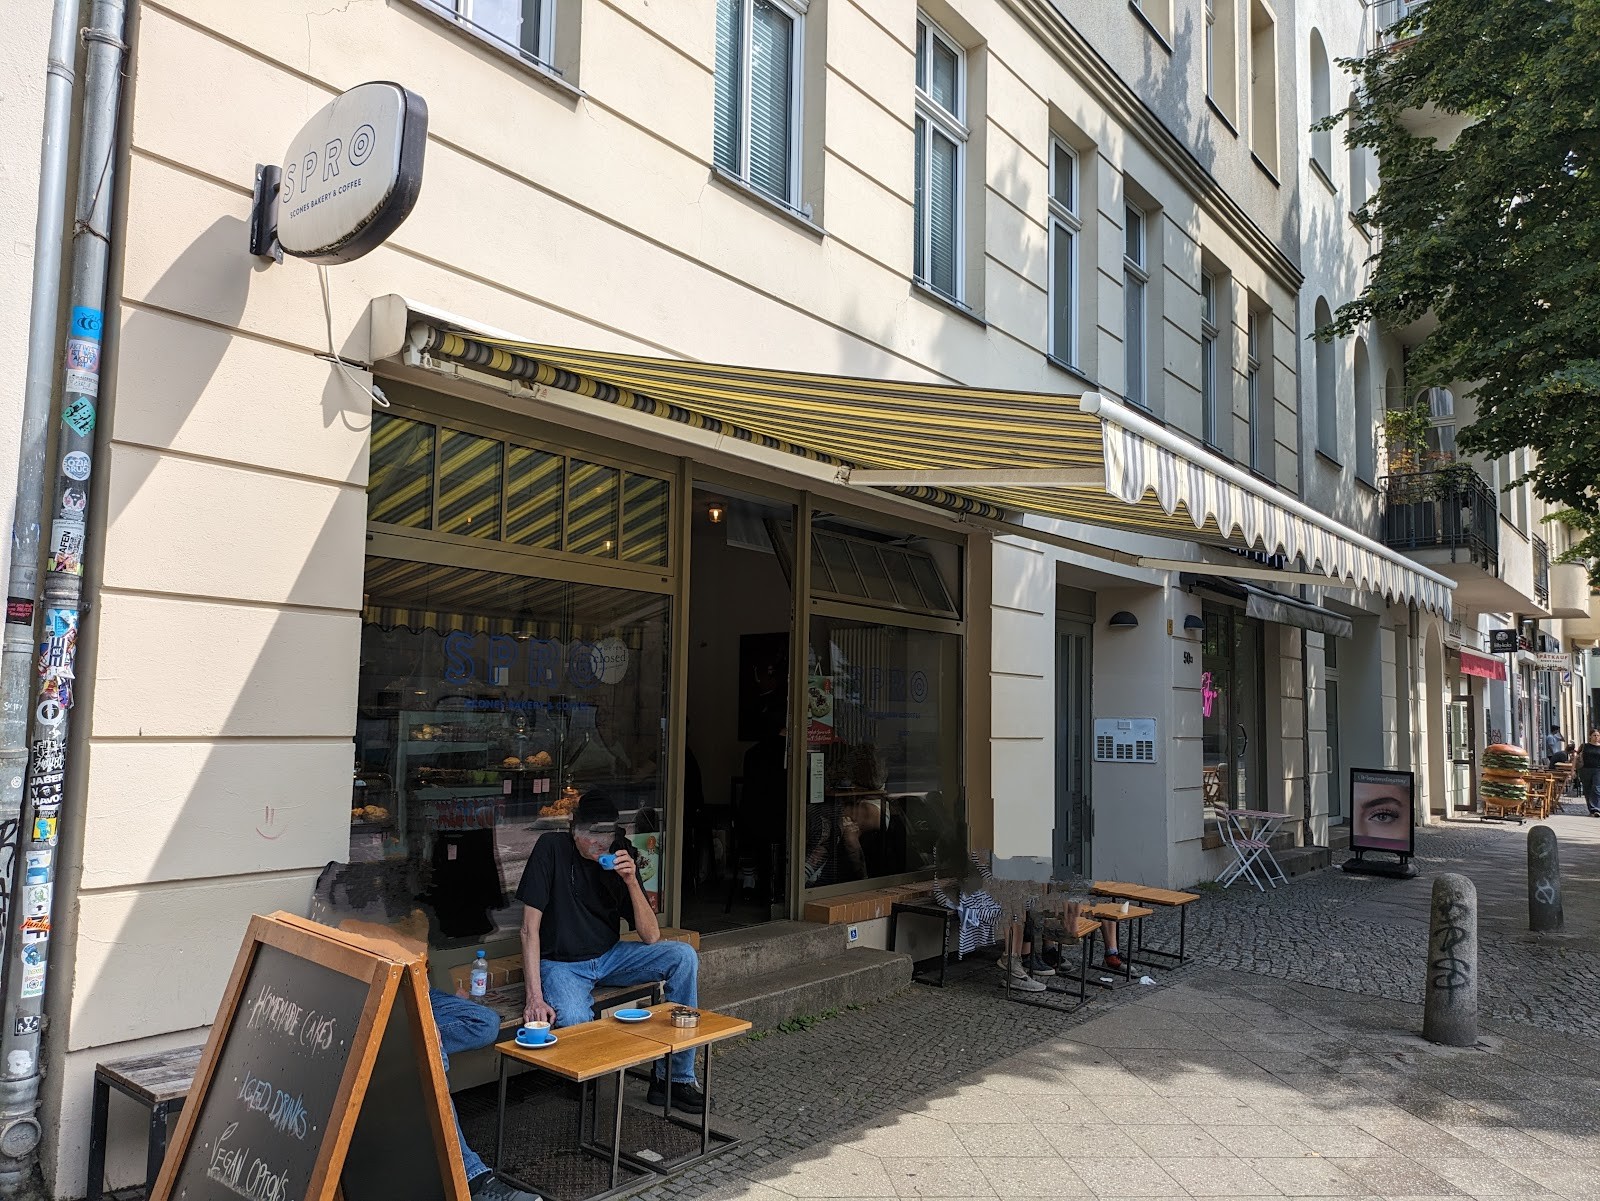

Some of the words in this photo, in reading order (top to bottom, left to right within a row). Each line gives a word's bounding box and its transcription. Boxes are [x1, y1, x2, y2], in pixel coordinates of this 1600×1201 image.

[283, 124, 375, 203] SPRO
[290, 203, 310, 219] SCONES
[310, 193, 332, 210] BAKERY
[332, 189, 337, 198] &
[338, 178, 362, 195] COFFEE
[248, 985, 304, 1037] HOMEMADE
[300, 1009, 336, 1056] CAKES
[237, 1070, 273, 1115] ICED
[269, 1089, 309, 1141] DRINKS
[208, 1136, 250, 1187] VEGAN
[246, 1156, 289, 1201] OPTIONS
